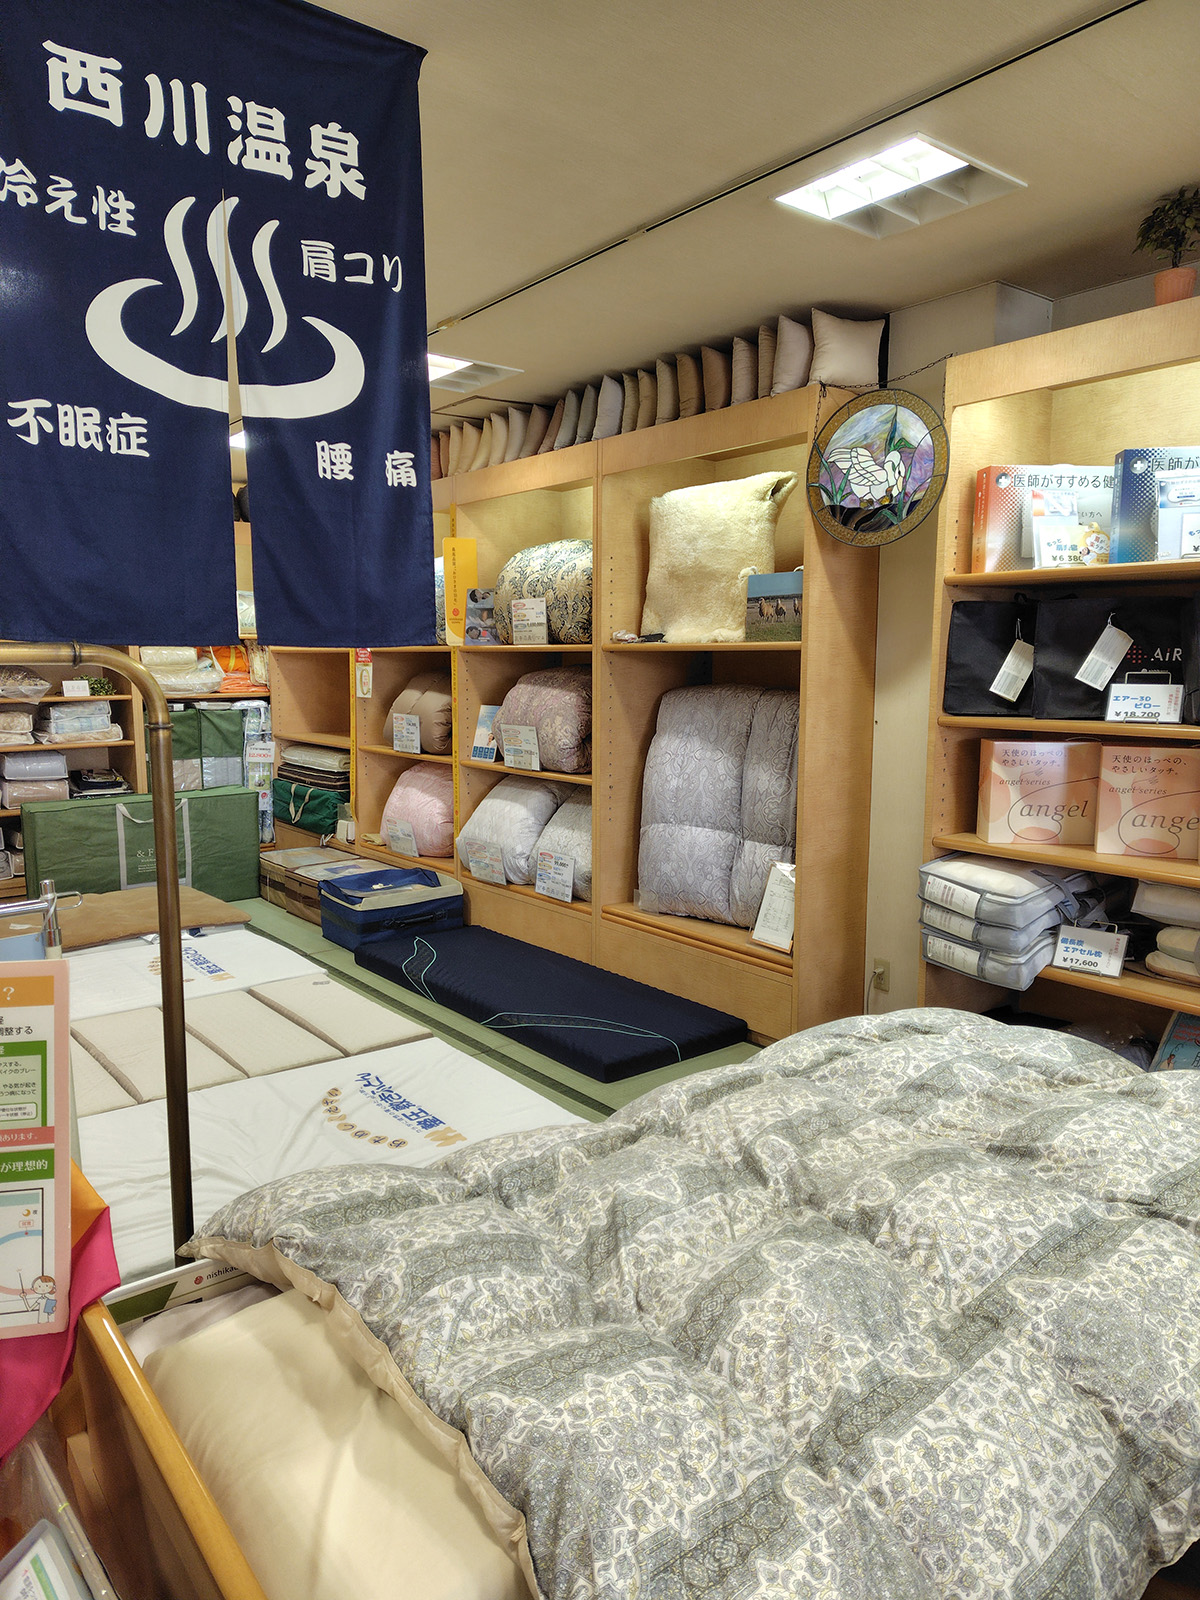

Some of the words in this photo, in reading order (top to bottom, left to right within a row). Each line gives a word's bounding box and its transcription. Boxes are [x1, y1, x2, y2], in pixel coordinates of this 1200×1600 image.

[42, 39, 367, 200] 西川温泉
[0, 156, 137, 237] 冷え性
[7, 398, 150, 457] 不眠症
[999, 778, 1024, 787] angel
[1108, 786, 1136, 794] angel
[1138, 787, 1168, 795] series
[1020, 800, 1089, 822] angel
[1062, 956, 1099, 968] ¥17,600
[0, 1159, 48, 1174] が理想的
